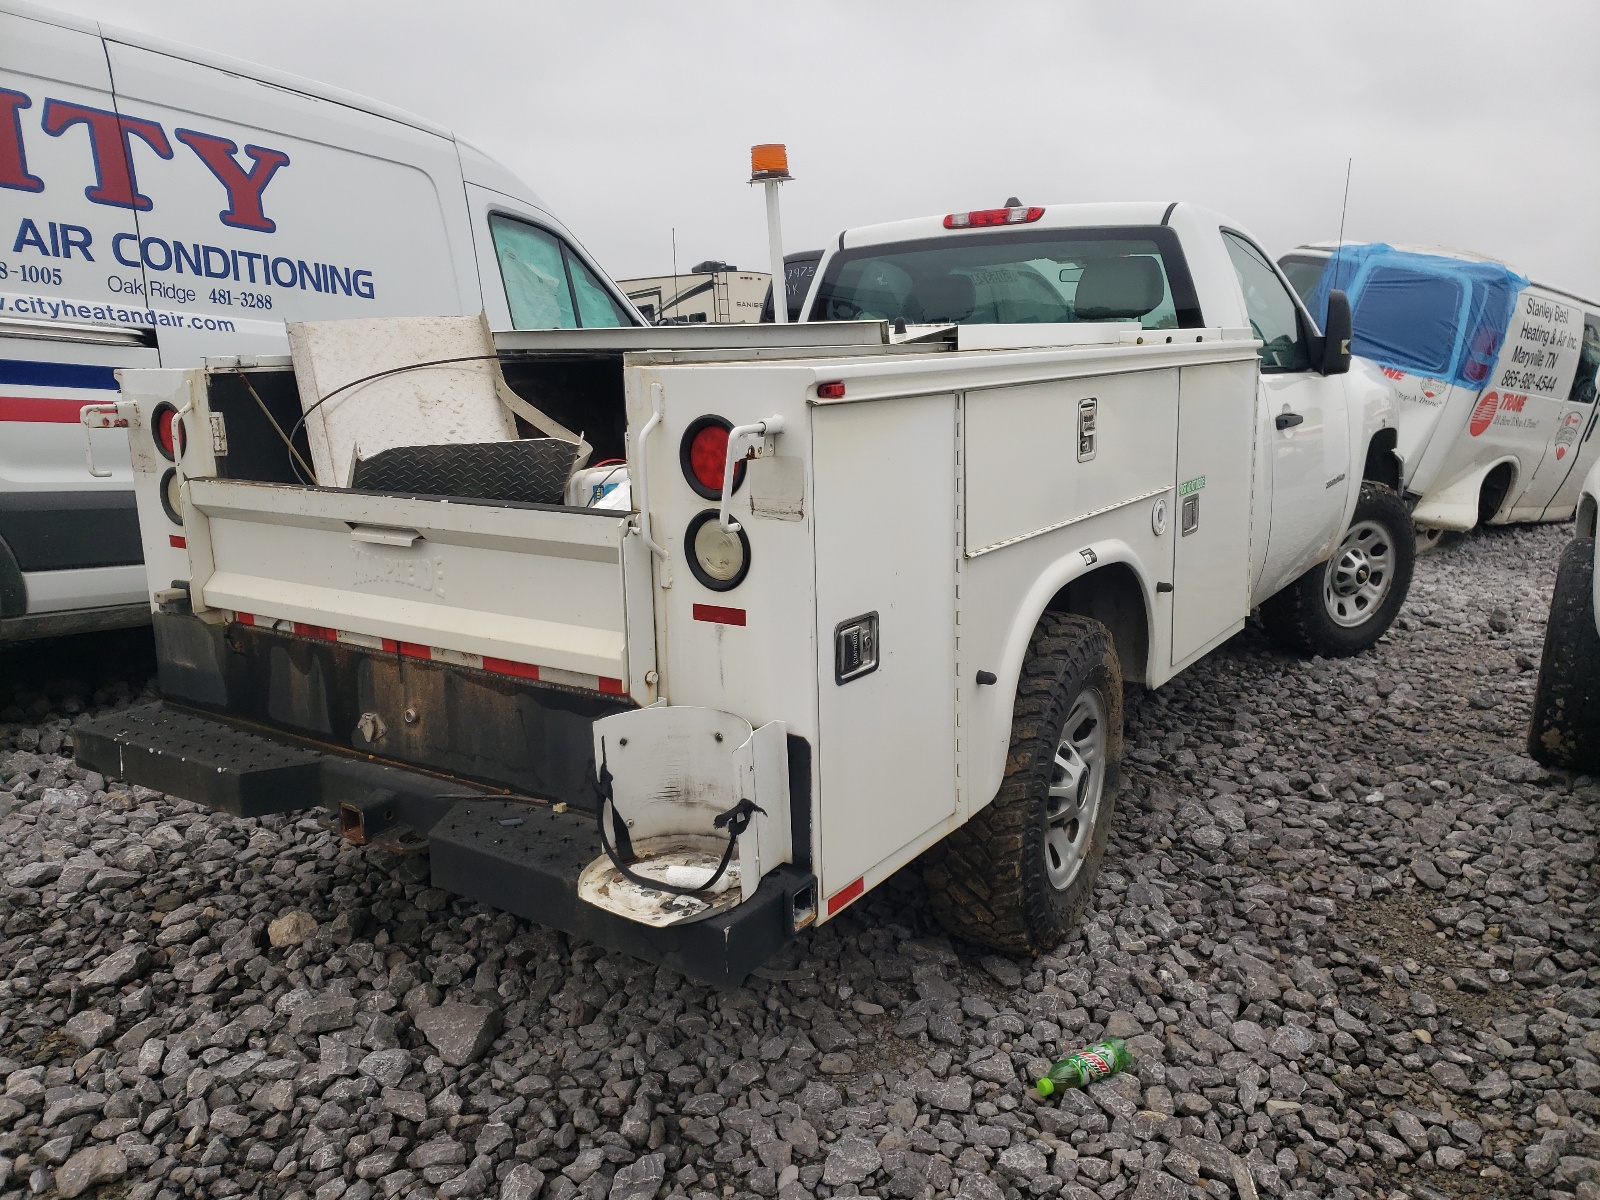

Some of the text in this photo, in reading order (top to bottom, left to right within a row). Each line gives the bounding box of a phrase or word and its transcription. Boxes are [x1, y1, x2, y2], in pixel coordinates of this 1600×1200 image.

[12, 218, 375, 299] AIR CONDITIONING
[108, 275, 273, 311] Oak Ridge 481-3288
[736, 301, 763, 309] SANIBE
[1526, 297, 1569, 323] Stanley Best
[1520, 321, 1550, 347] Heating
[1550, 328, 1557, 345] &
[1556, 330, 1567, 348] Air
[1545, 352, 1559, 369] TN
[1499, 393, 1527, 412] TRANE
